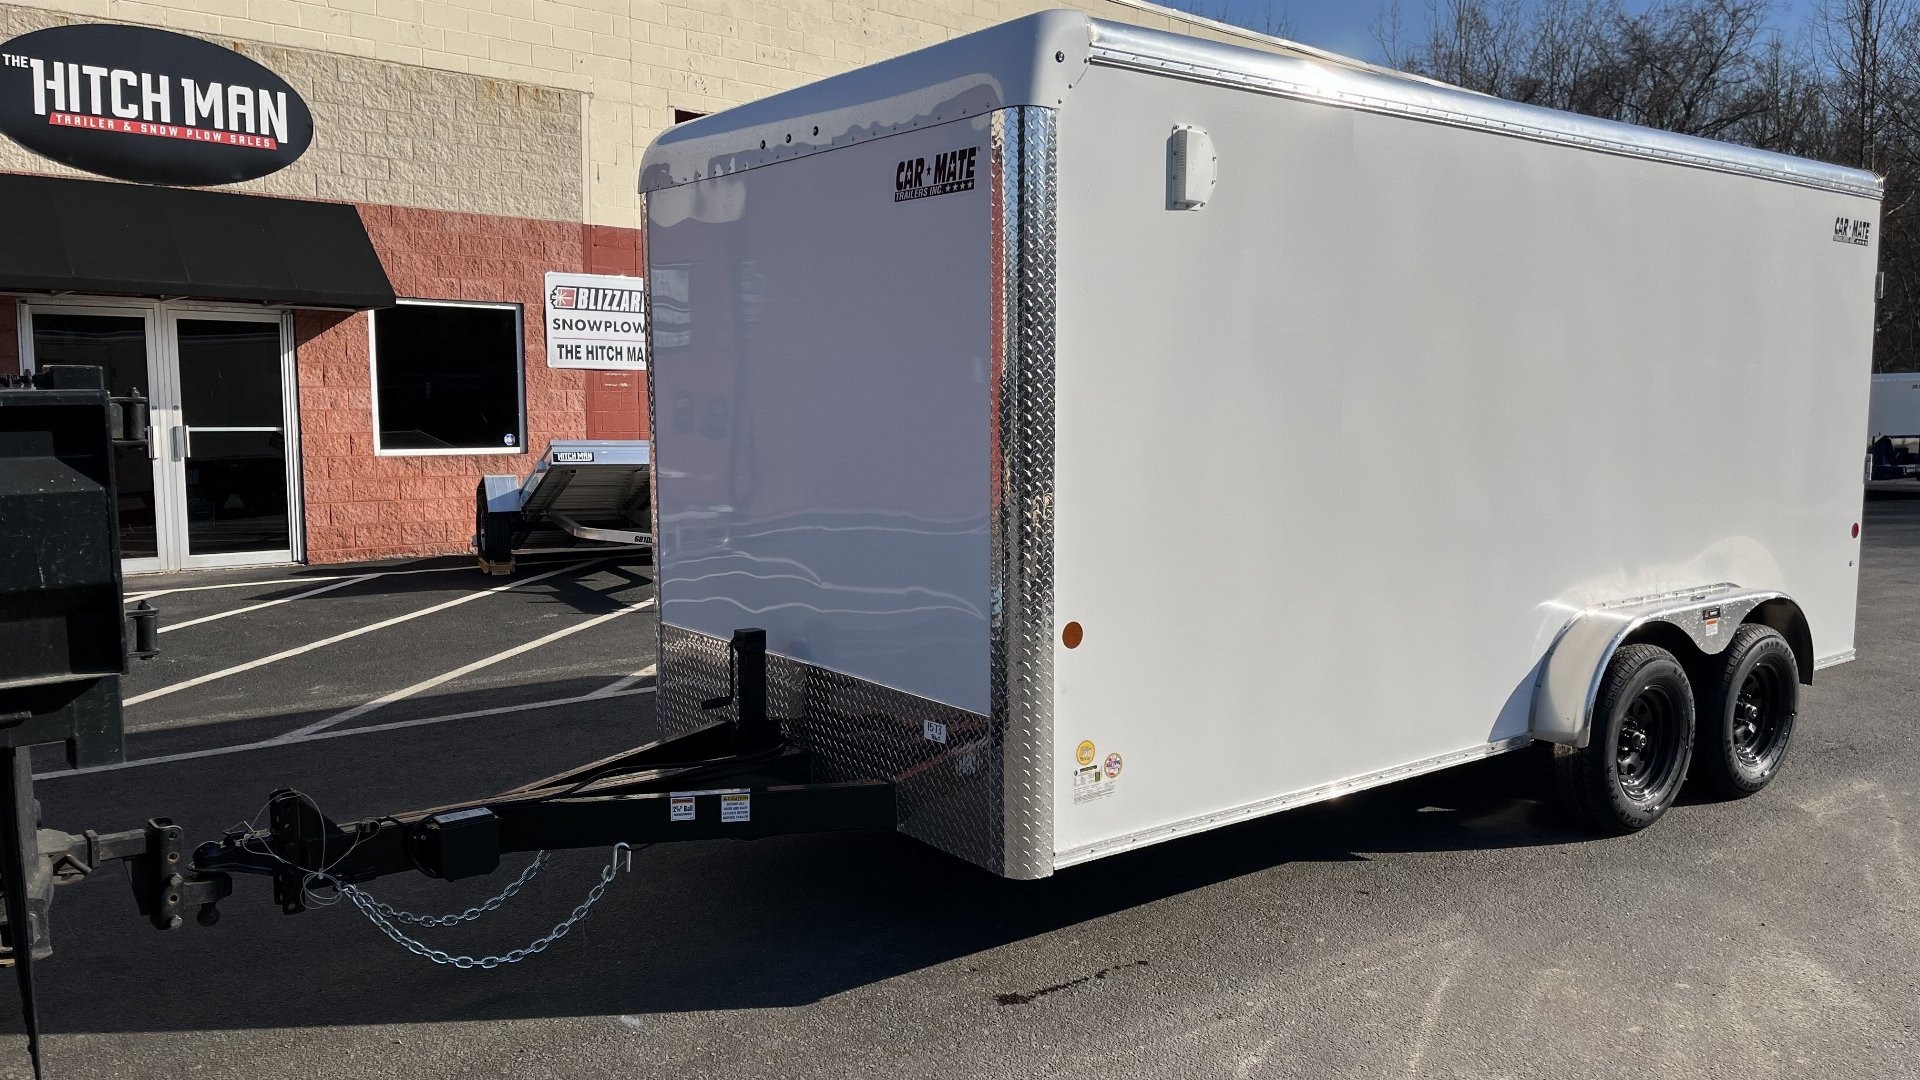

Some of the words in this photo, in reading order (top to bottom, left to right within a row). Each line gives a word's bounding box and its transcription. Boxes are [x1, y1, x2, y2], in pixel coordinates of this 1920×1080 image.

[2, 53, 29, 68] THE
[30, 58, 171, 123] HITCH
[180, 78, 288, 144] MAN
[55, 114, 115, 130] TRAILER
[123, 121, 132, 131] &
[140, 124, 179, 137] SNOW
[186, 129, 222, 142] PLOW
[230, 135, 270, 148] SALES
[895, 158, 924, 191] CAR
[933, 147, 977, 184] MATE
[895, 187, 928, 201] TRAILERS
[929, 185, 944, 196] INC.
[1835, 217, 1849, 236] CAR
[1852, 220, 1870, 240] MATE
[577, 288, 644, 312] BLIZZAR
[557, 344, 581, 360] THE
[586, 345, 623, 361] HITCH
[627, 347, 646, 362] MA
